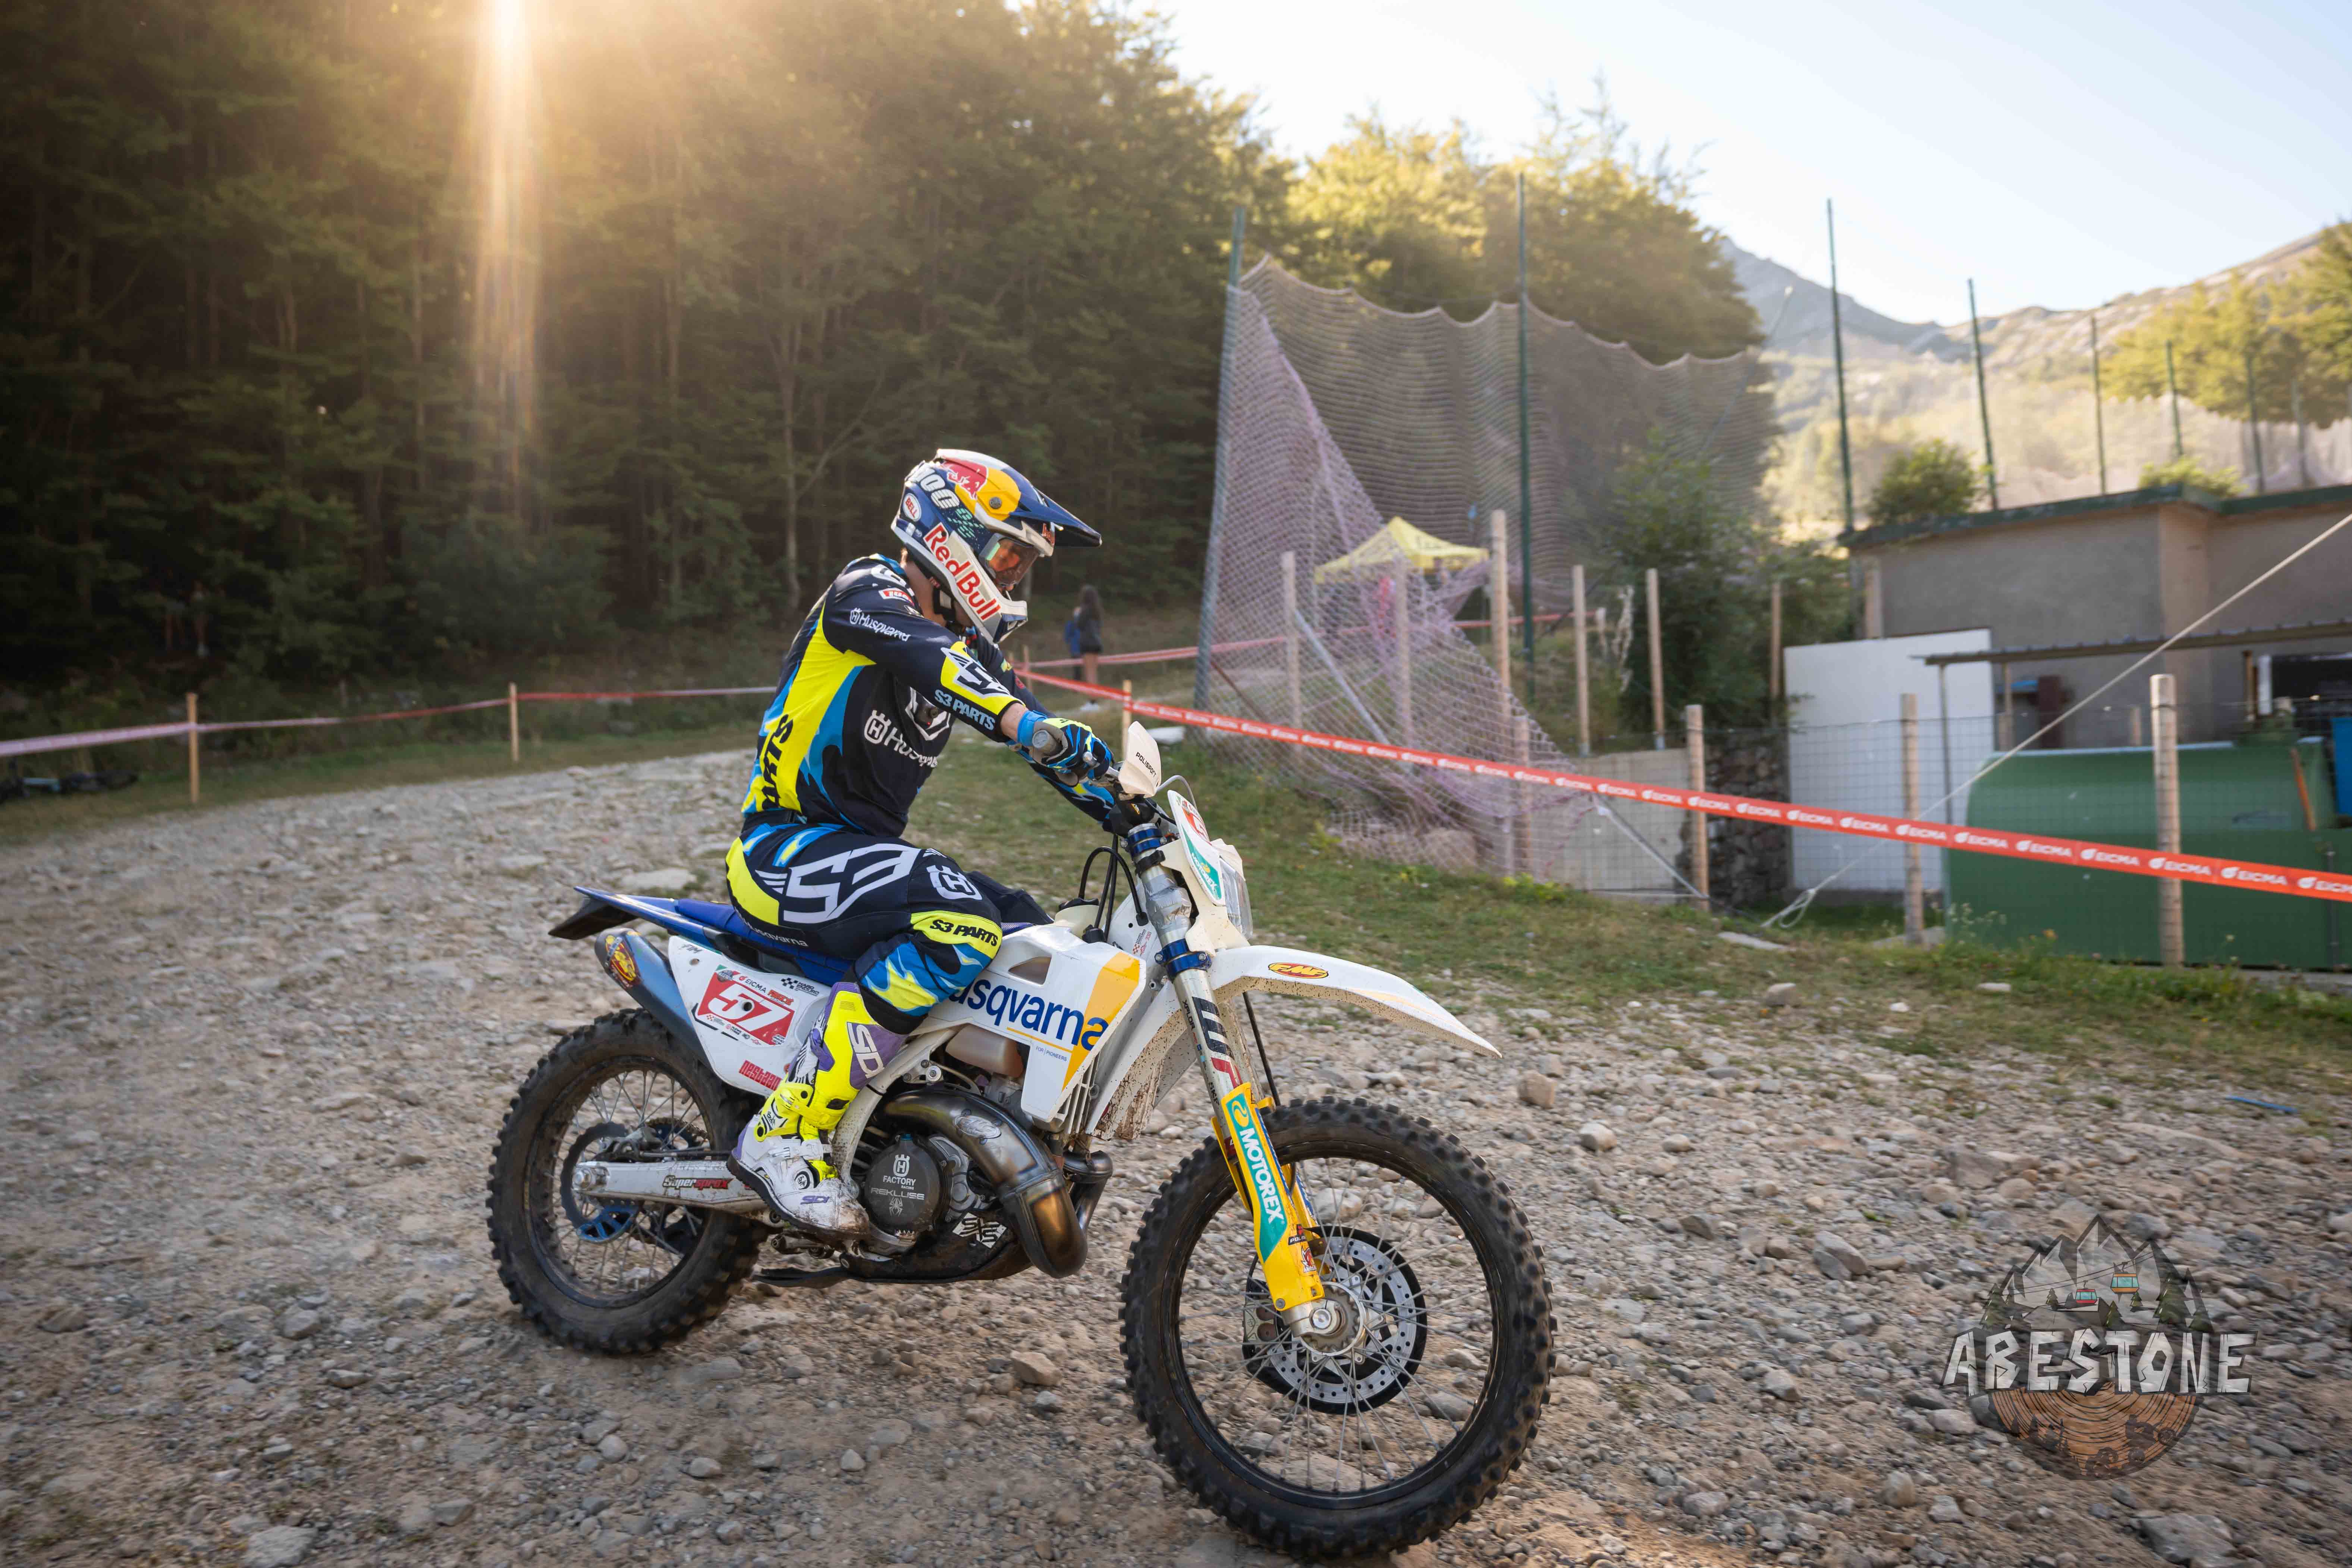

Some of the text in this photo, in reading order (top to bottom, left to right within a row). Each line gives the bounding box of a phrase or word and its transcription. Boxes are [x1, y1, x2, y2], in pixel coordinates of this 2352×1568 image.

[905, 497, 917, 518] BELL
[925, 524, 1001, 620] Red Bull
[934, 689, 995, 731] S3 PARTS
[762, 714, 794, 810] ARTS
[1136, 752, 1157, 777] POLISPORT
[1968, 836, 2009, 849] EICMA
[2029, 843, 2072, 857] EICMA
[2095, 852, 2140, 866] EICMA
[2164, 860, 2213, 875] EICMA
[2236, 870, 2287, 886] EICMA
[2314, 880, 2352, 894] EICM
[930, 920, 998, 946] S3 PARTS
[1269, 963, 1328, 978] FMF
[745, 979, 767, 993] EICMA
[708, 983, 791, 1032] 57
[1046, 1049, 1067, 1062] PIONEERS
[1209, 1082, 1220, 1106] SKF
[883, 1175, 916, 1186] FACTORY
[1239, 1127, 1284, 1224] MOTOREX
[871, 1187, 924, 1200] REKLUSE
